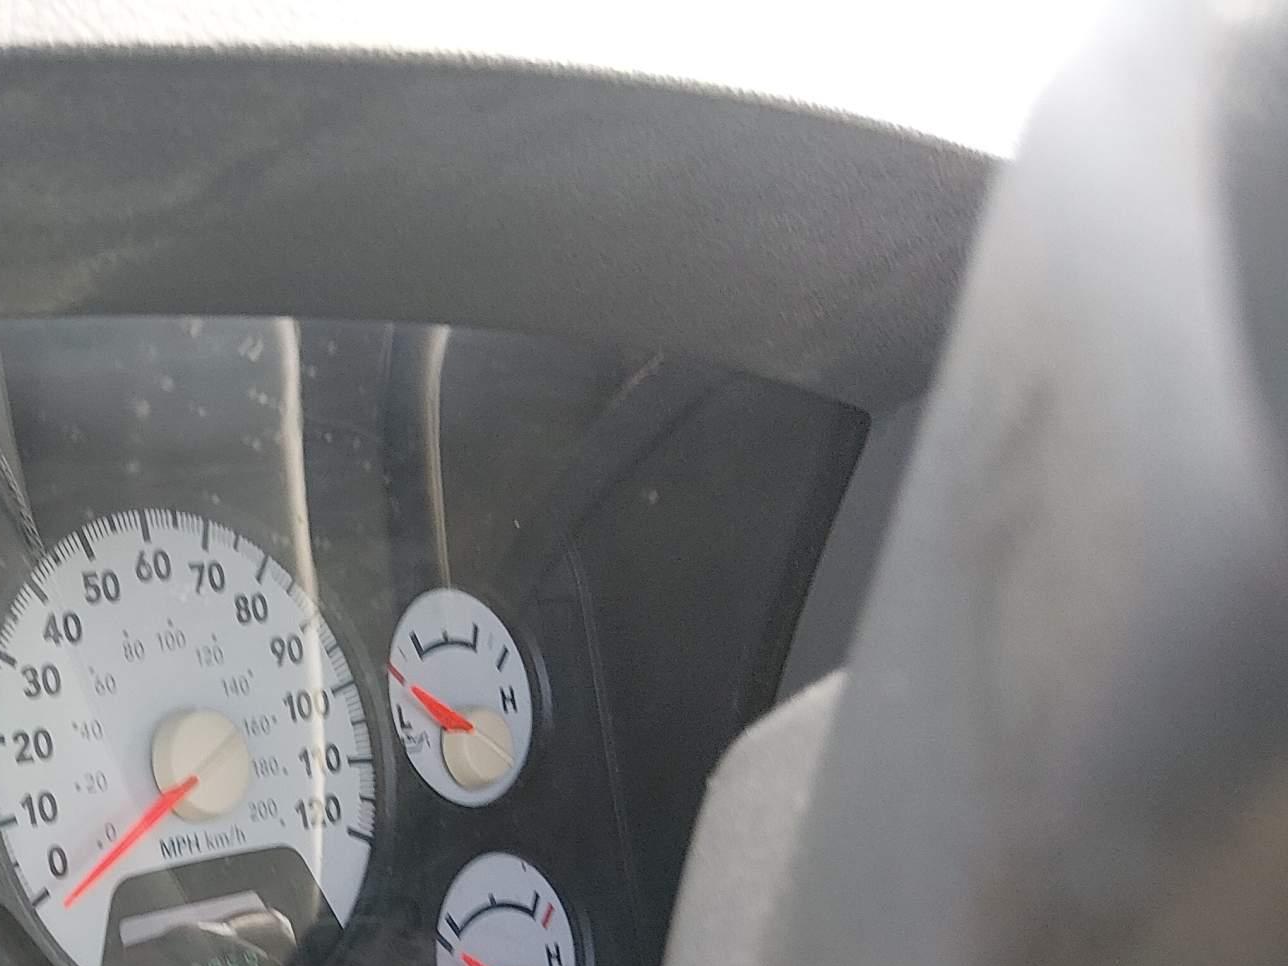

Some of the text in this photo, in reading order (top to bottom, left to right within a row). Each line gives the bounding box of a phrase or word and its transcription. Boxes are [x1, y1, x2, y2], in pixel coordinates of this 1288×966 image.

[135, 549, 172, 582] 60
[189, 560, 226, 594] 70
[82, 569, 121, 605] 50
[235, 592, 268, 625] 80
[43, 611, 82, 647] 40
[156, 629, 187, 653] 100
[123, 639, 145, 664] 80
[196, 644, 225, 669] 120
[270, 635, 304, 668] 90
[20, 664, 62, 699] 30
[94, 673, 116, 697] 60
[222, 675, 251, 698] 140
[283, 690, 330, 723] 100
[499, 686, 518, 714] H
[80, 719, 104, 742] 40
[245, 714, 271, 738] 160
[13, 728, 53, 764] 20
[83, 772, 108, 795] 20
[254, 758, 280, 778] 180
[21, 791, 58, 827] 10
[249, 799, 279, 823] 200
[295, 794, 342, 830] 120
[106, 822, 117, 842] 0
[160, 824, 247, 860] MPH km/h
[48, 847, 68, 879] 0
